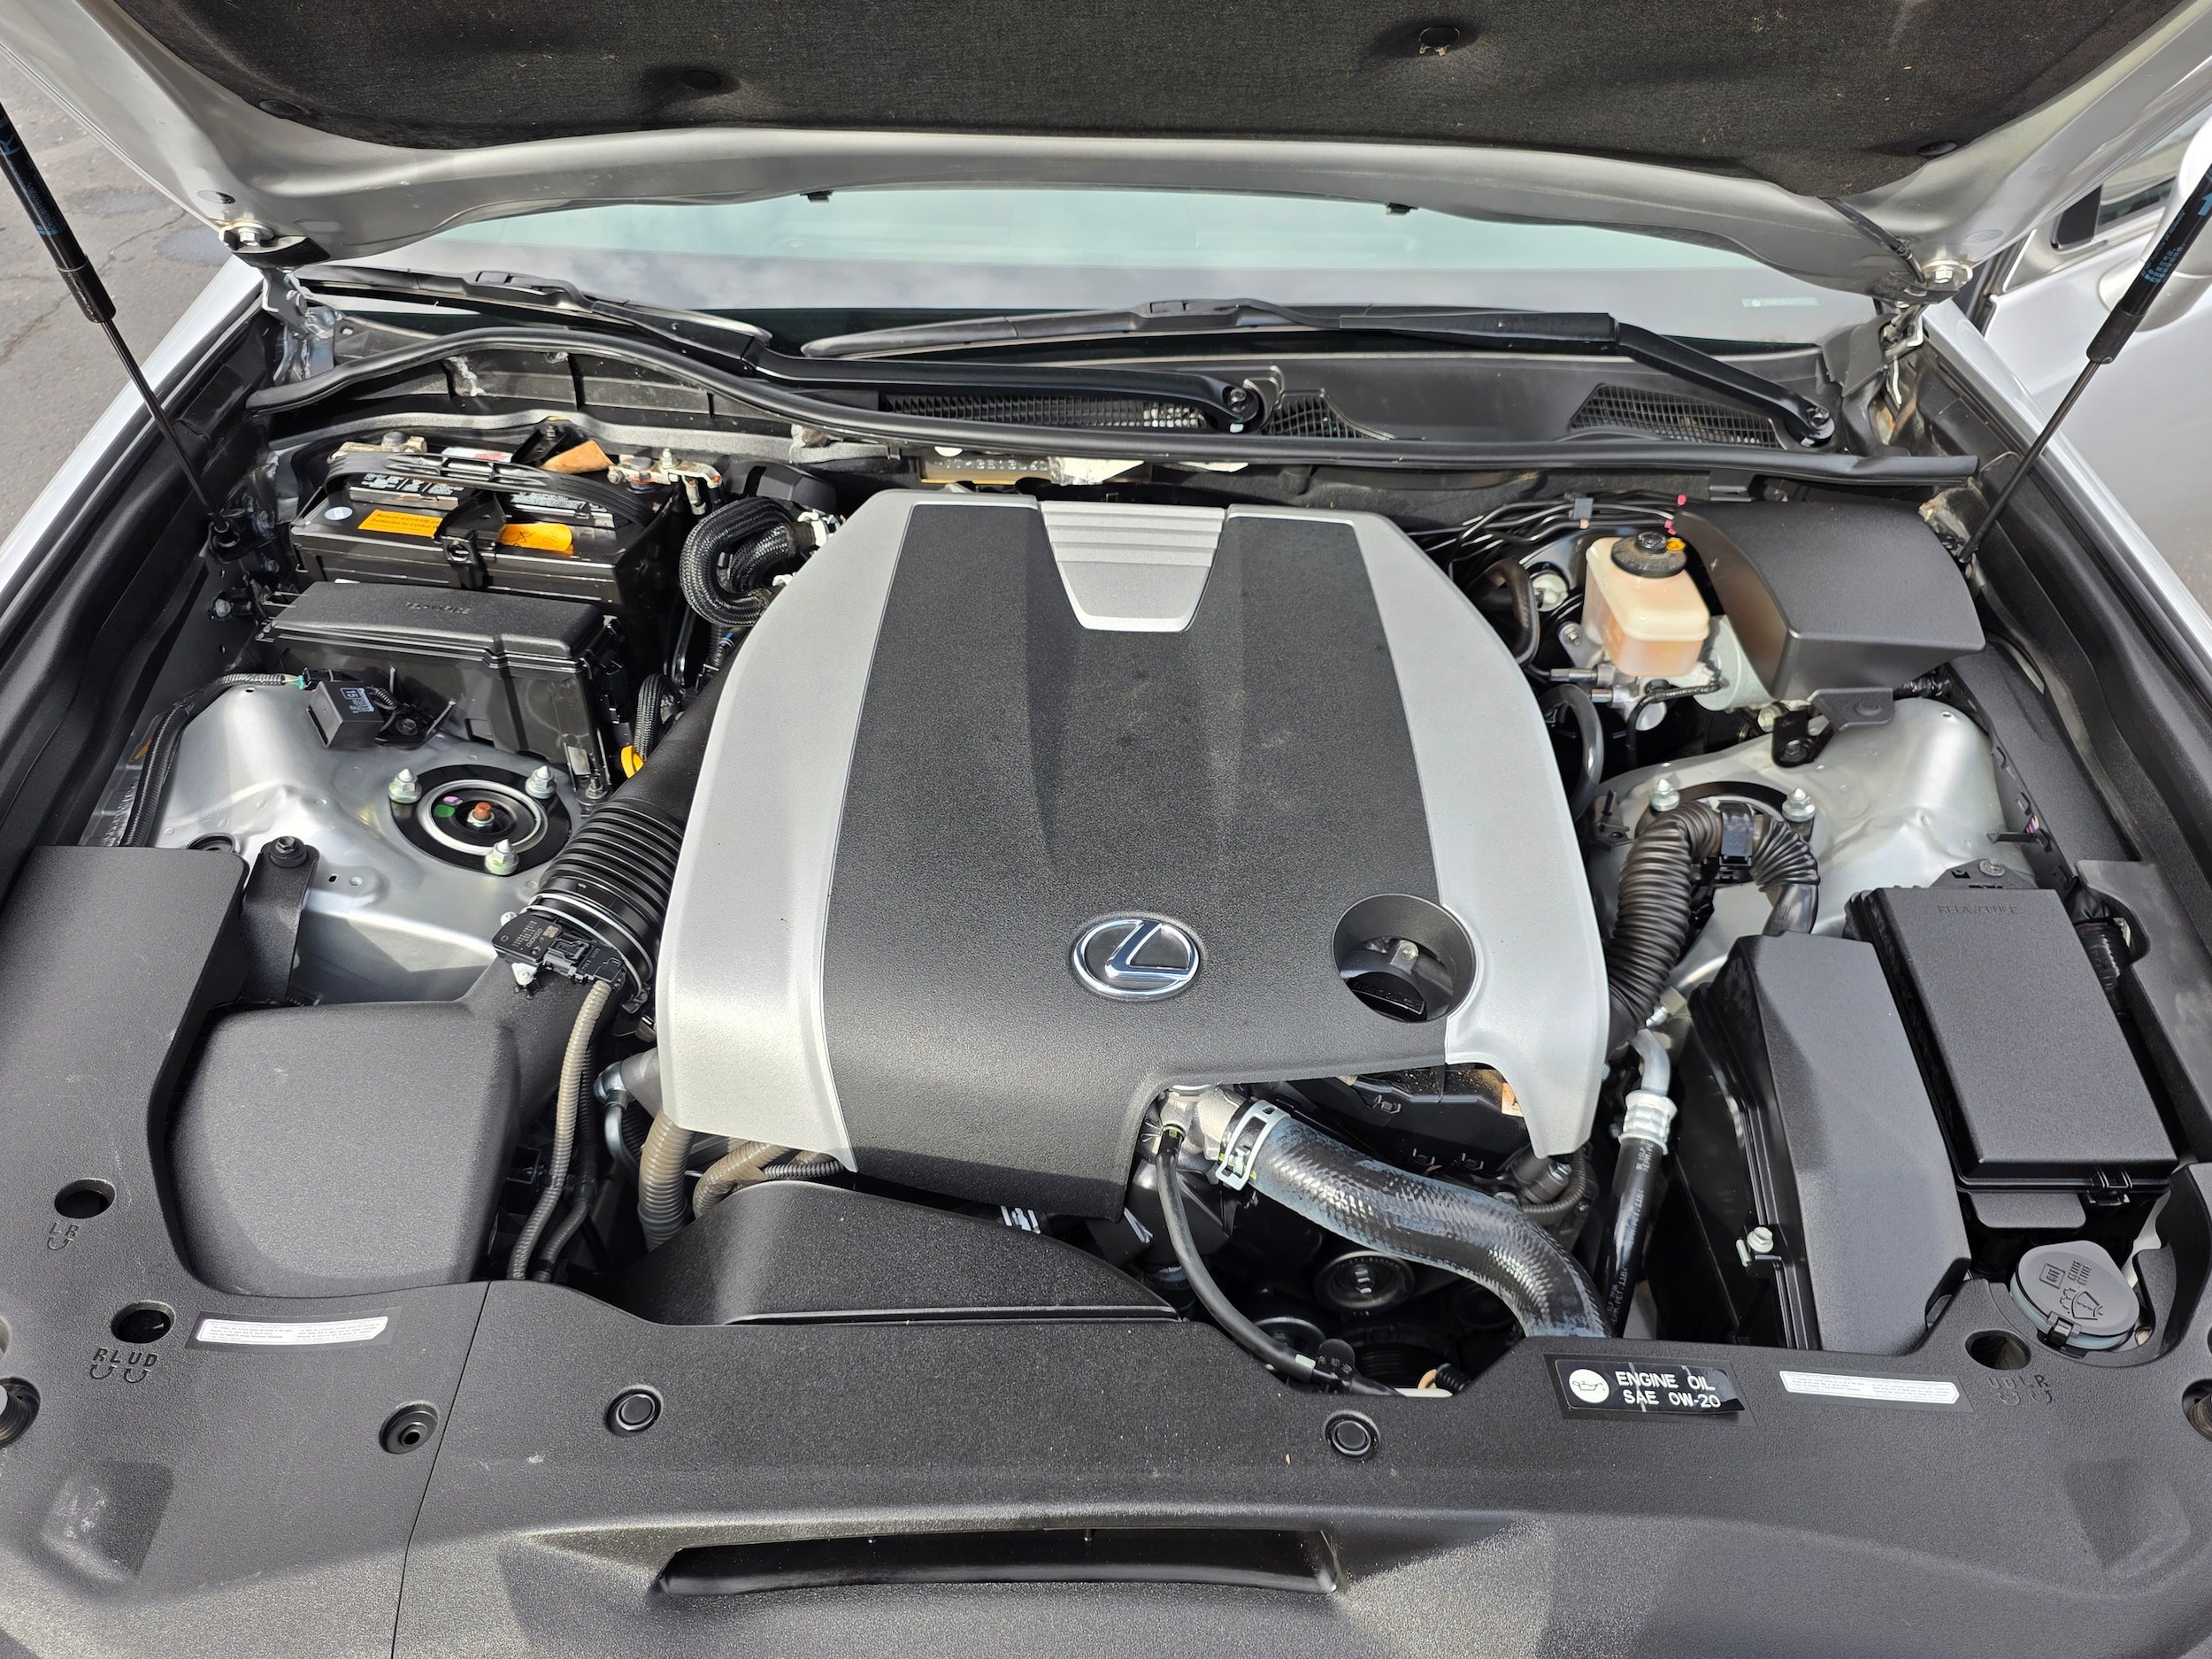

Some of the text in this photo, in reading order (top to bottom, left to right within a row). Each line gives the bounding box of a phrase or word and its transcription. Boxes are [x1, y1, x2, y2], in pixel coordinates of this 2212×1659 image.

[526, 928, 542, 948] DENSO
[1615, 1371, 1716, 1391] ENGINE OIL
[1623, 1390, 1721, 1409] SAE 0W-20
